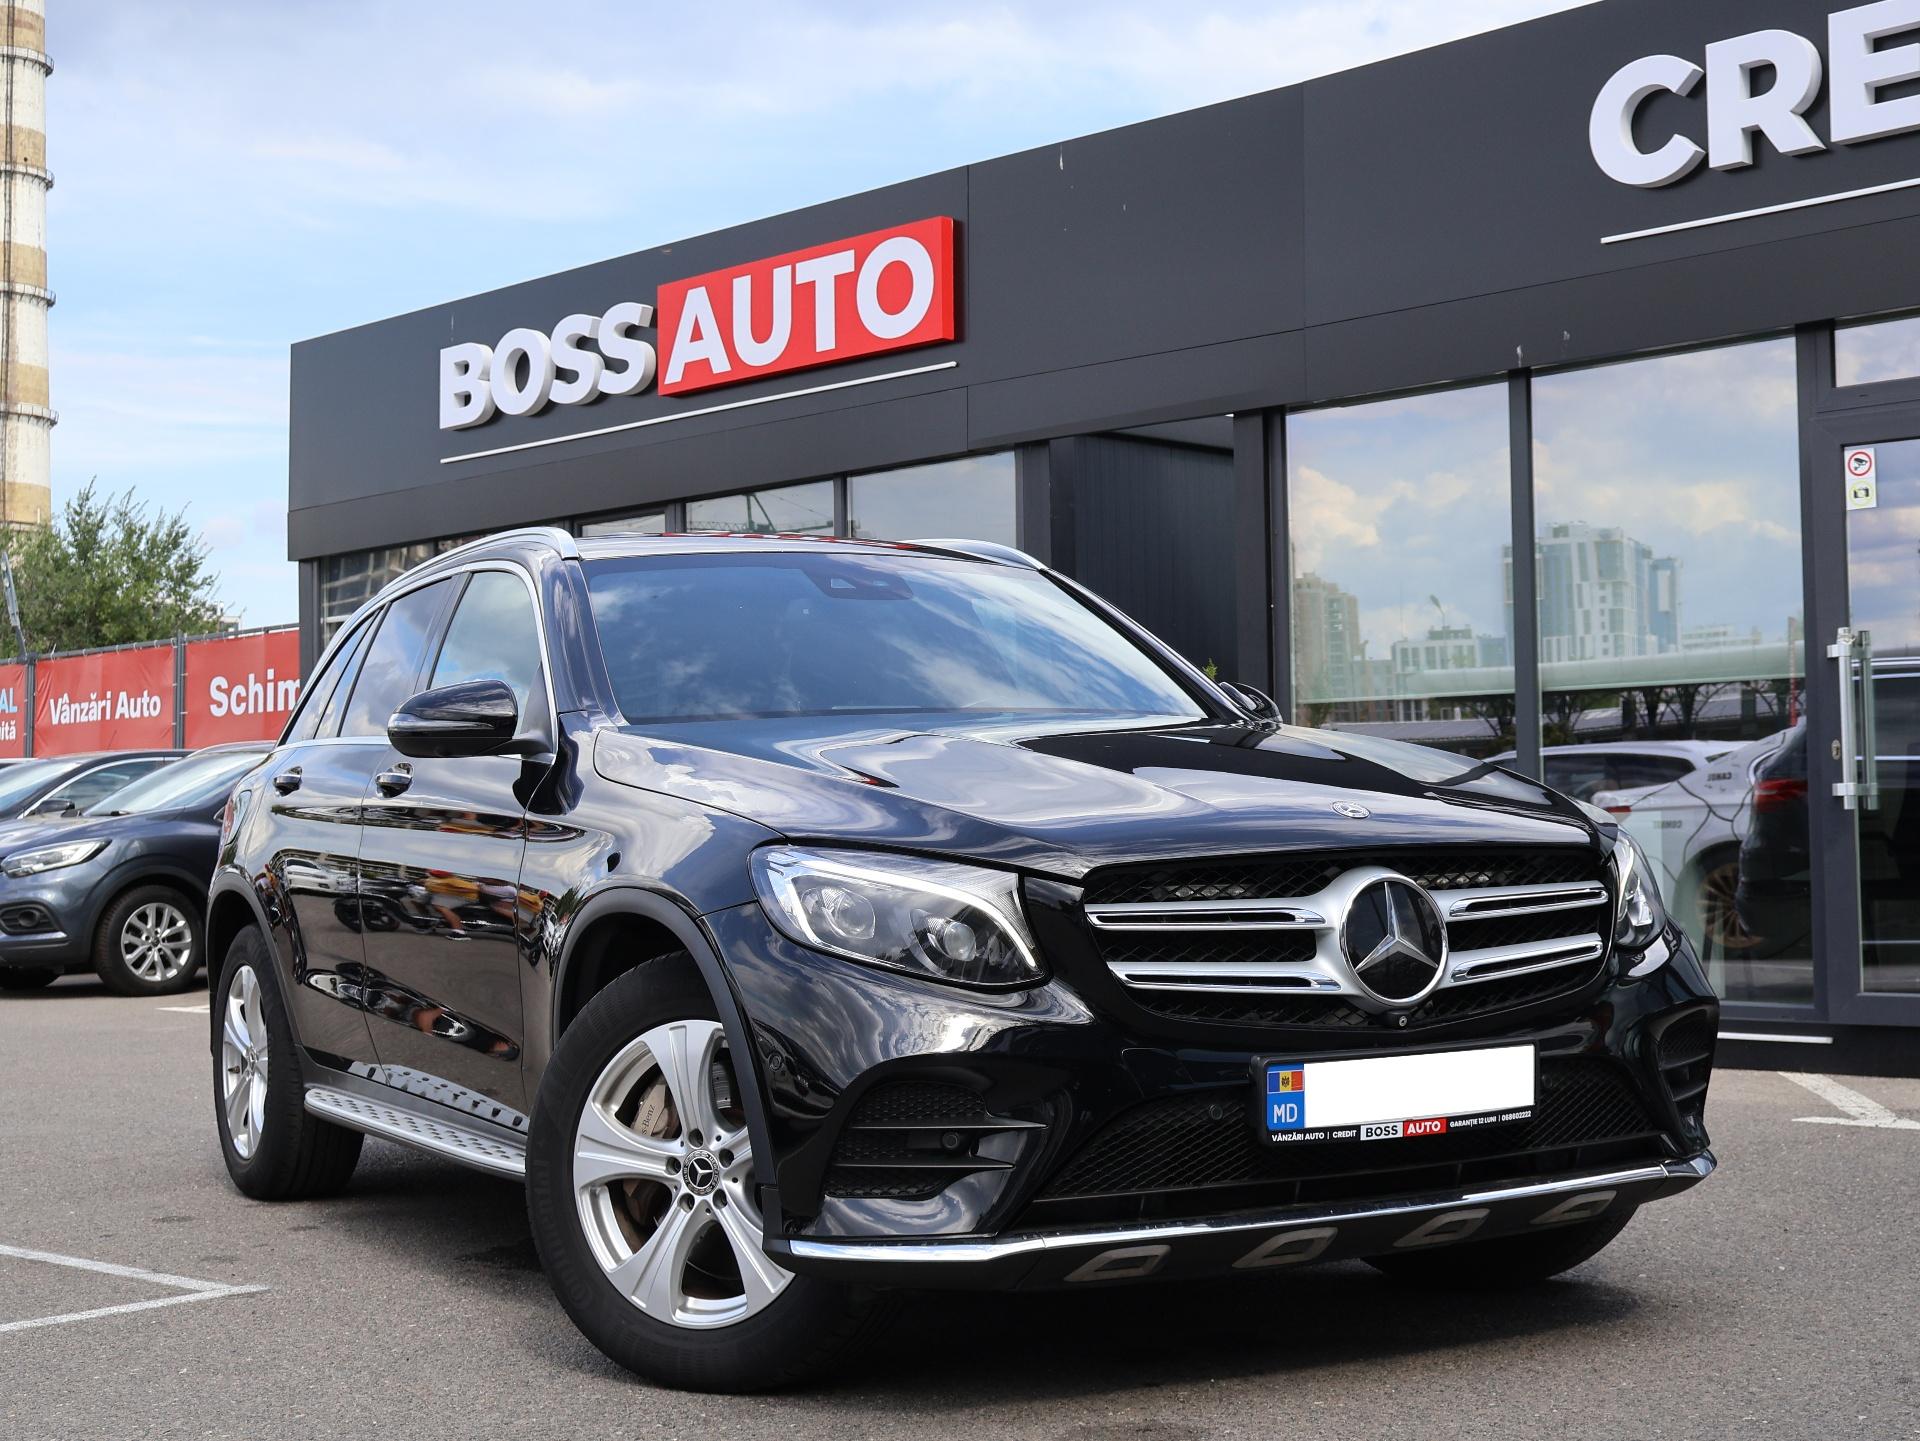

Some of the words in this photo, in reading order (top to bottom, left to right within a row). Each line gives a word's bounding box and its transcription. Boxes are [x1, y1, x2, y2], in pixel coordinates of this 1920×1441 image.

[1589, 0, 1920, 188] CRE
[440, 302, 657, 430] BOSS
[664, 236, 935, 385] AUTO
[49, 690, 111, 726] Vânzări
[115, 689, 161, 720] Auto
[1271, 1131, 1304, 1142] VÂNZĂRI
[1304, 1132, 1325, 1140] AUTO
[1332, 1130, 1357, 1139] CREDIT
[1365, 1125, 1399, 1138] BOSS
[1407, 1121, 1441, 1135] AUTO
[1484, 1115, 1497, 1123] LUNI
[1273, 1103, 1298, 1124] MD
